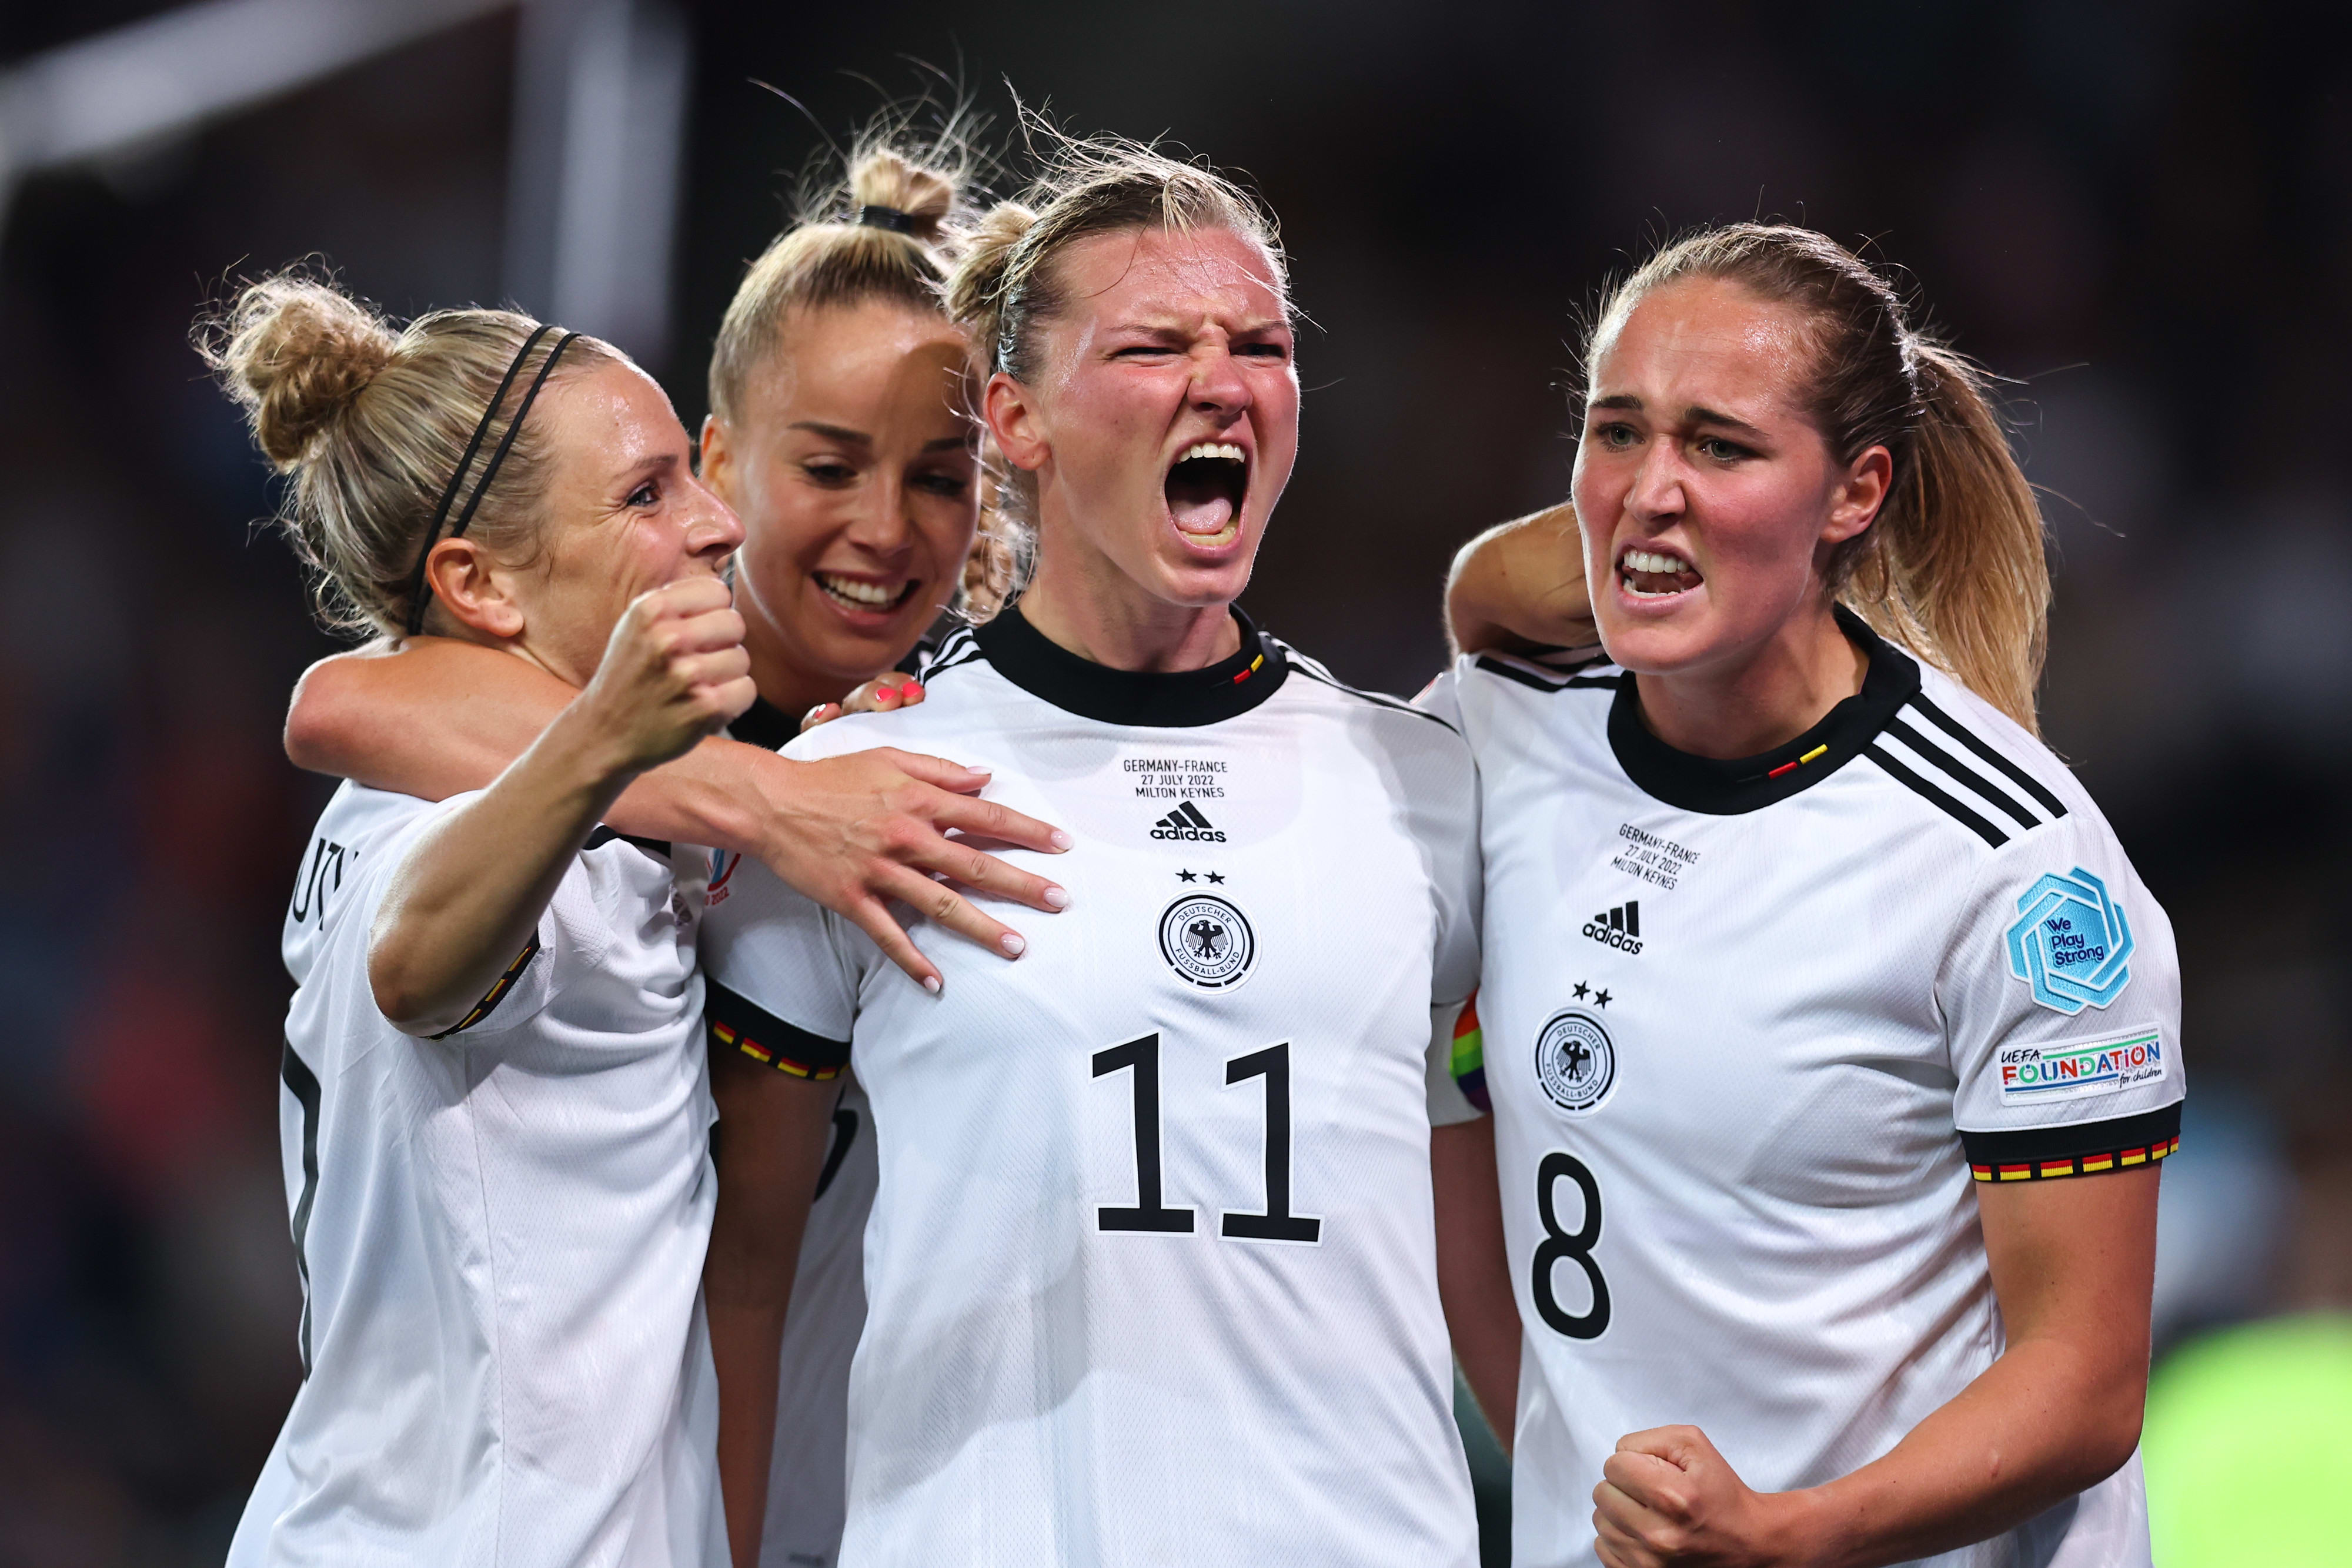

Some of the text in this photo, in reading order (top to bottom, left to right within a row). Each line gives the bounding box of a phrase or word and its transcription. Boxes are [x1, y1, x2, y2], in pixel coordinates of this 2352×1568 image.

[1124, 759, 1228, 773] GERMANY-FRANCE
[1141, 774, 1214, 785] 27 JULY 2022
[1135, 787, 1225, 798] MILTON KEYNES
[1150, 826, 1227, 842] adidas
[1619, 823, 1700, 865] GERMANY-FRANCE
[1625, 844, 1682, 875] 27 JULY 2022
[1611, 855, 1678, 891] MILTON KEYNES
[1178, 906, 1231, 924] DEUTSCHER
[2047, 917, 2072, 934] We
[1582, 922, 1643, 955] adidas
[2051, 933, 2084, 949] Play
[1175, 948, 1240, 975] FUSSBALL-BUND
[2054, 945, 2105, 966] Strong
[1556, 1025, 1601, 1051] DEUTSCHER
[2001, 1048, 2041, 1064] UEFA
[2002, 1041, 2160, 1086] FOUNDATION
[1546, 1062, 1598, 1098] FUSSBALL-BUND
[2119, 1067, 2163, 1088] for children
[1091, 1031, 1323, 1243] 11
[1531, 1152, 1611, 1340] 8
